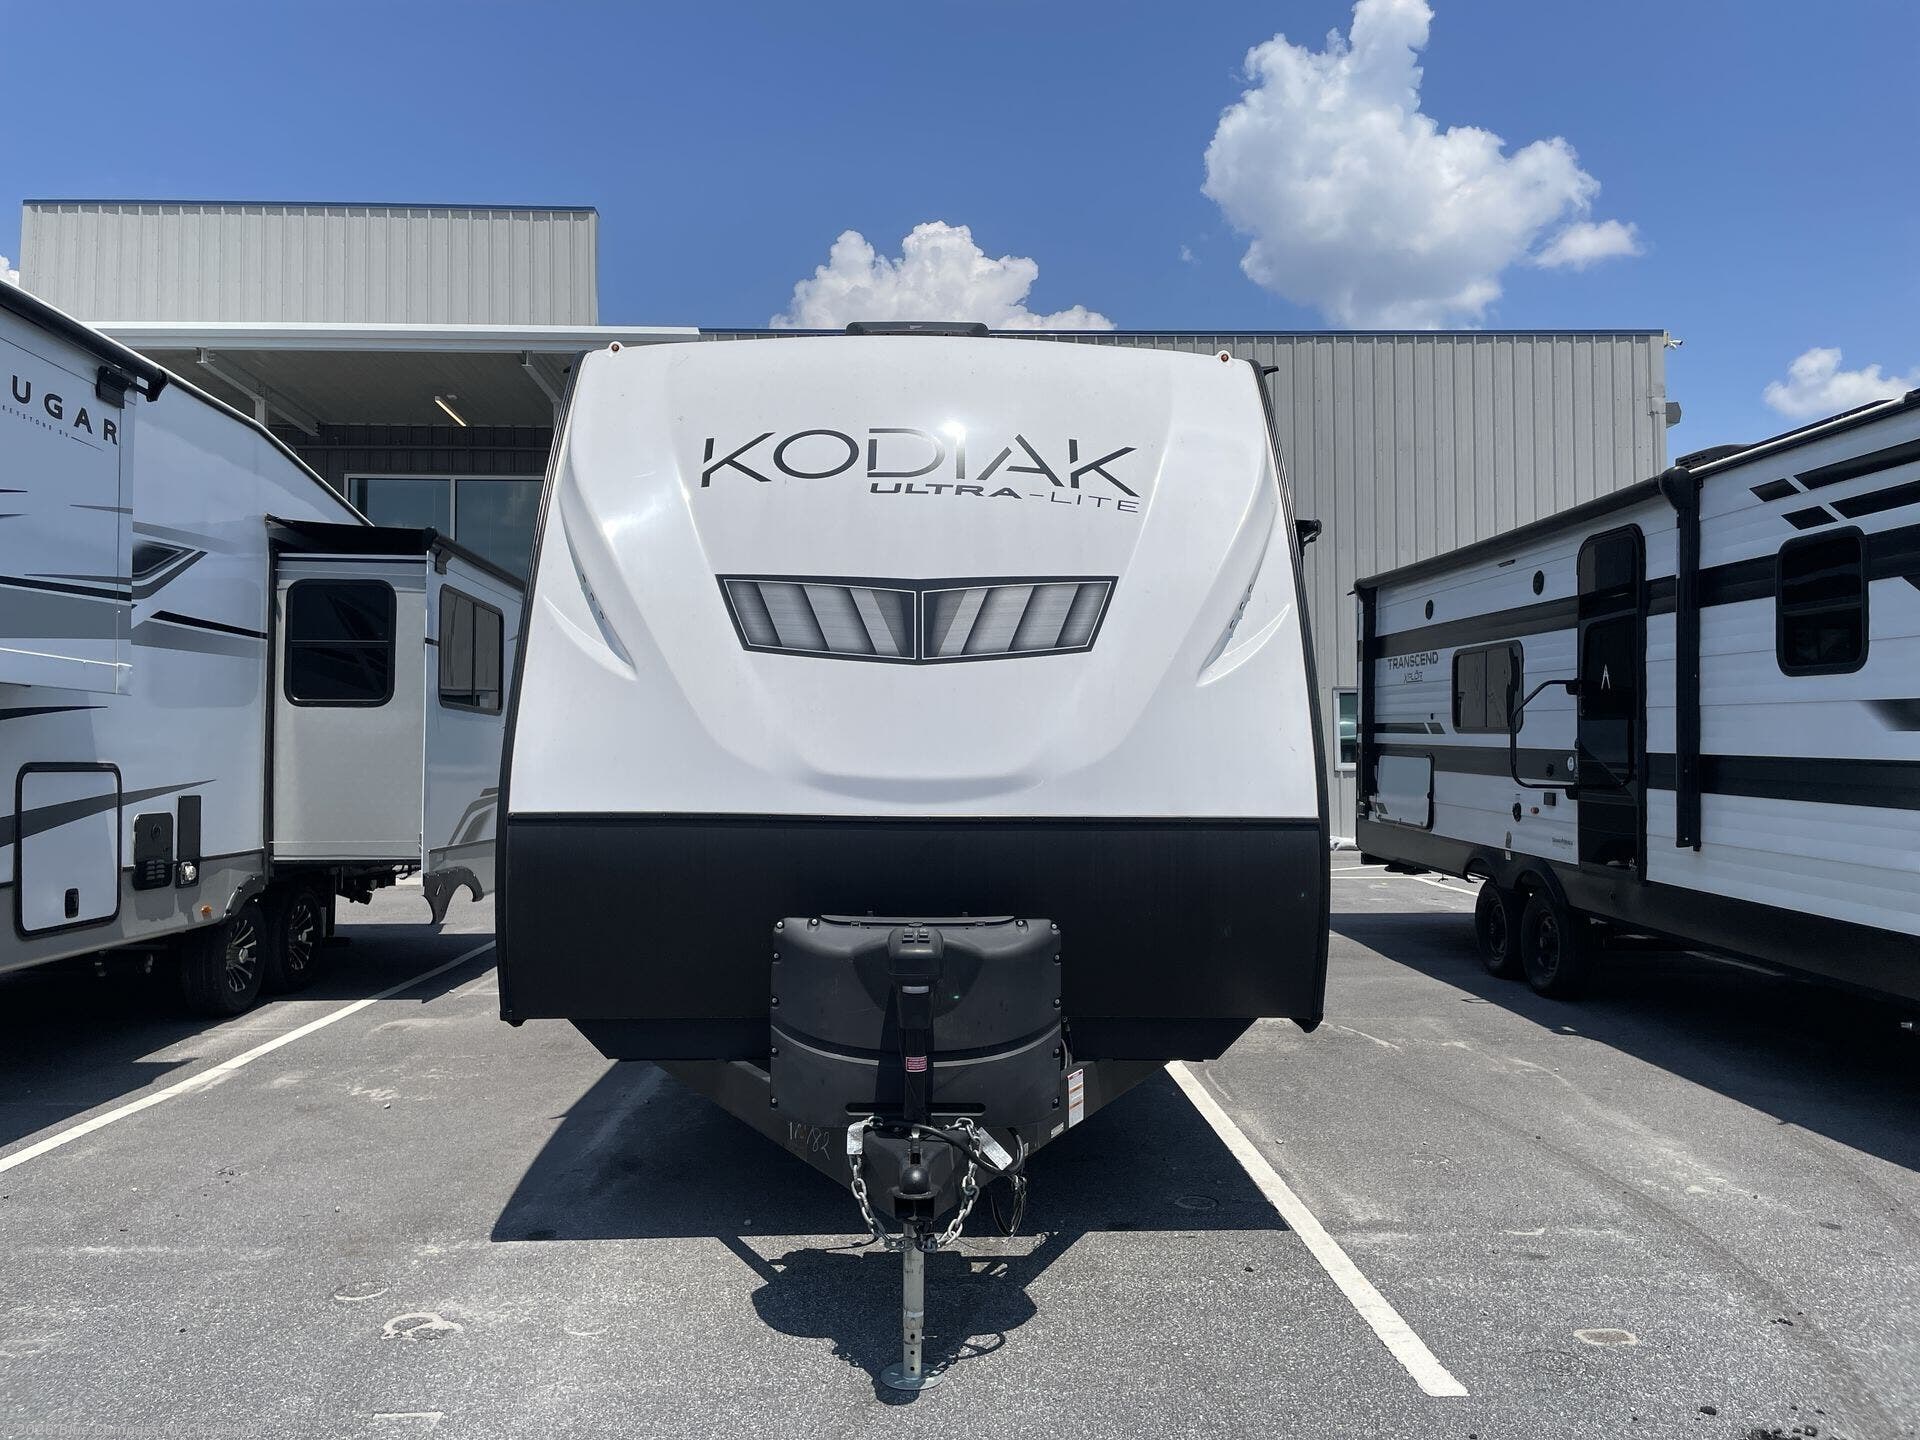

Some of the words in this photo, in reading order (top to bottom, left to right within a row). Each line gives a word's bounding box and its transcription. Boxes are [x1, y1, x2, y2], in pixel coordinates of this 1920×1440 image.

[12, 374, 118, 446] UGAR
[700, 427, 1141, 498] KODIAK
[869, 481, 1141, 513] ULTRA-LITE
[1387, 651, 1439, 670] TRANSCEND
